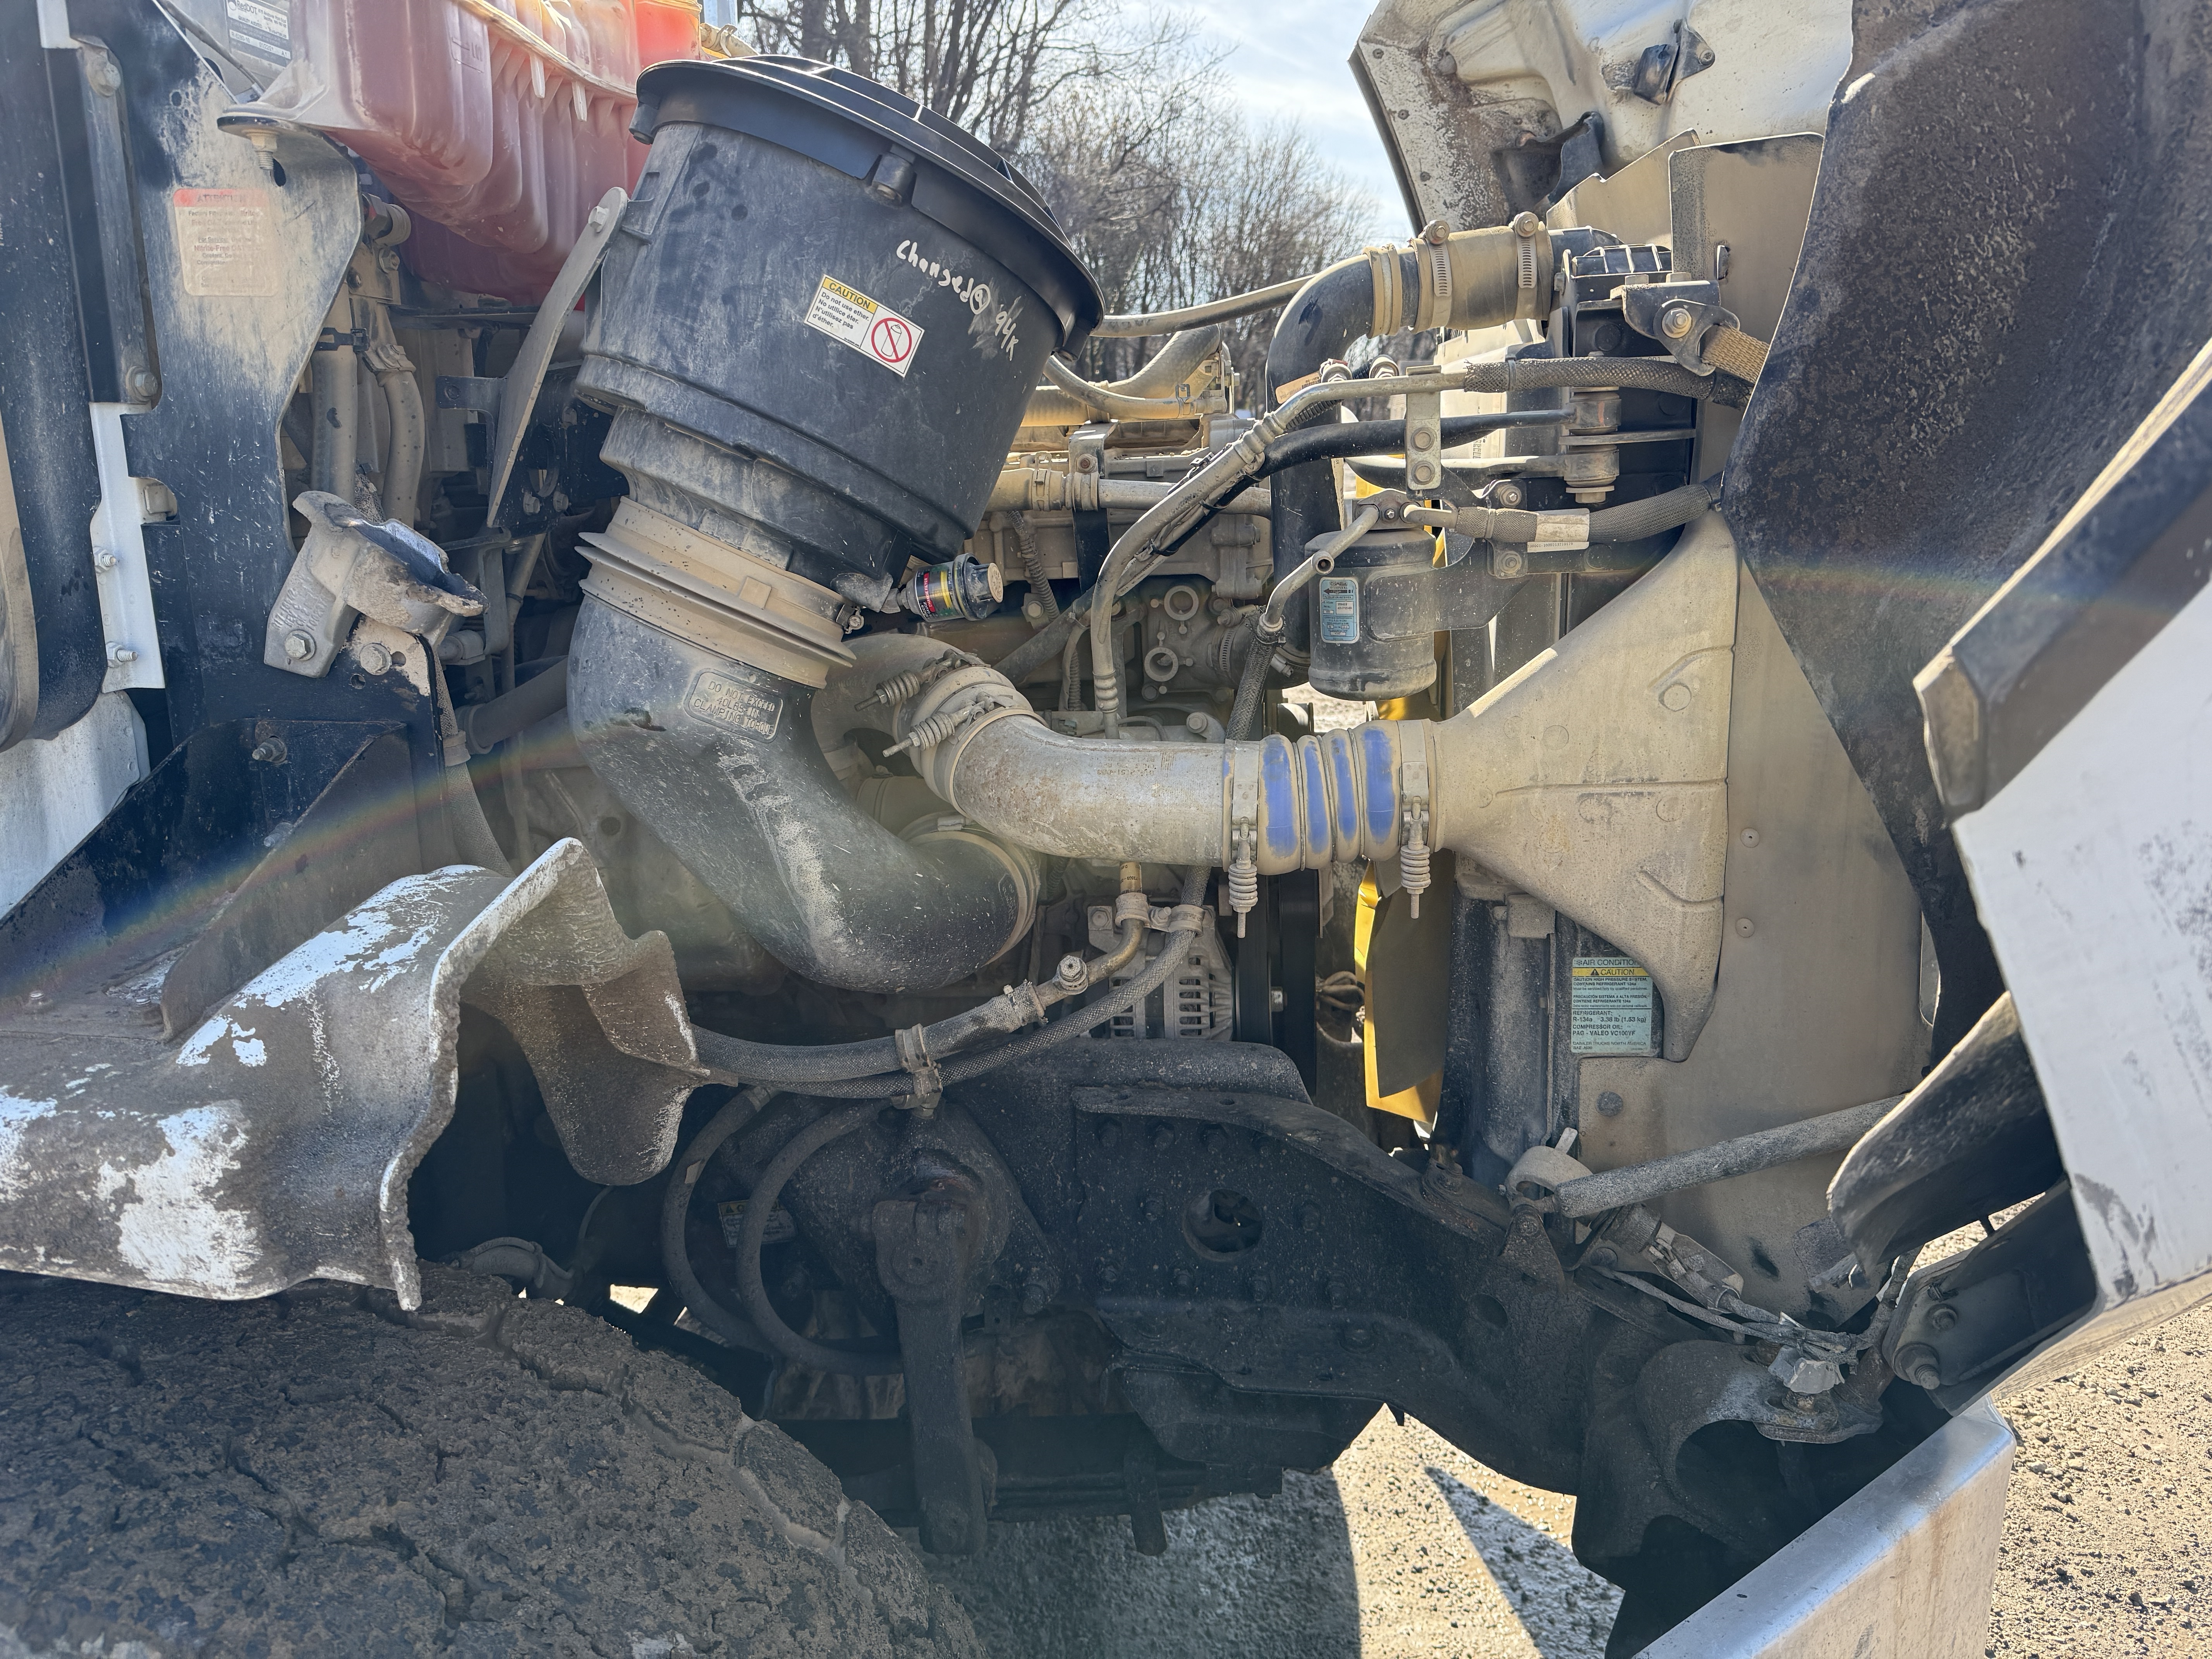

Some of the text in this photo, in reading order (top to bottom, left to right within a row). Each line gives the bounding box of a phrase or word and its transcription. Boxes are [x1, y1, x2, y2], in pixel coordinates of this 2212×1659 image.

[829, 283, 871, 309] CAUTION
[812, 314, 833, 328] d'éther.
[815, 306, 854, 329] N'utilisez pas
[818, 299, 859, 324] No utilice éter.
[831, 297, 841, 306] not
[842, 302, 852, 311] use
[854, 309, 869, 321] ether.
[708, 681, 775, 712] DO NOT EXCEED
[694, 699, 775, 735] CLAMPING TORQUE
